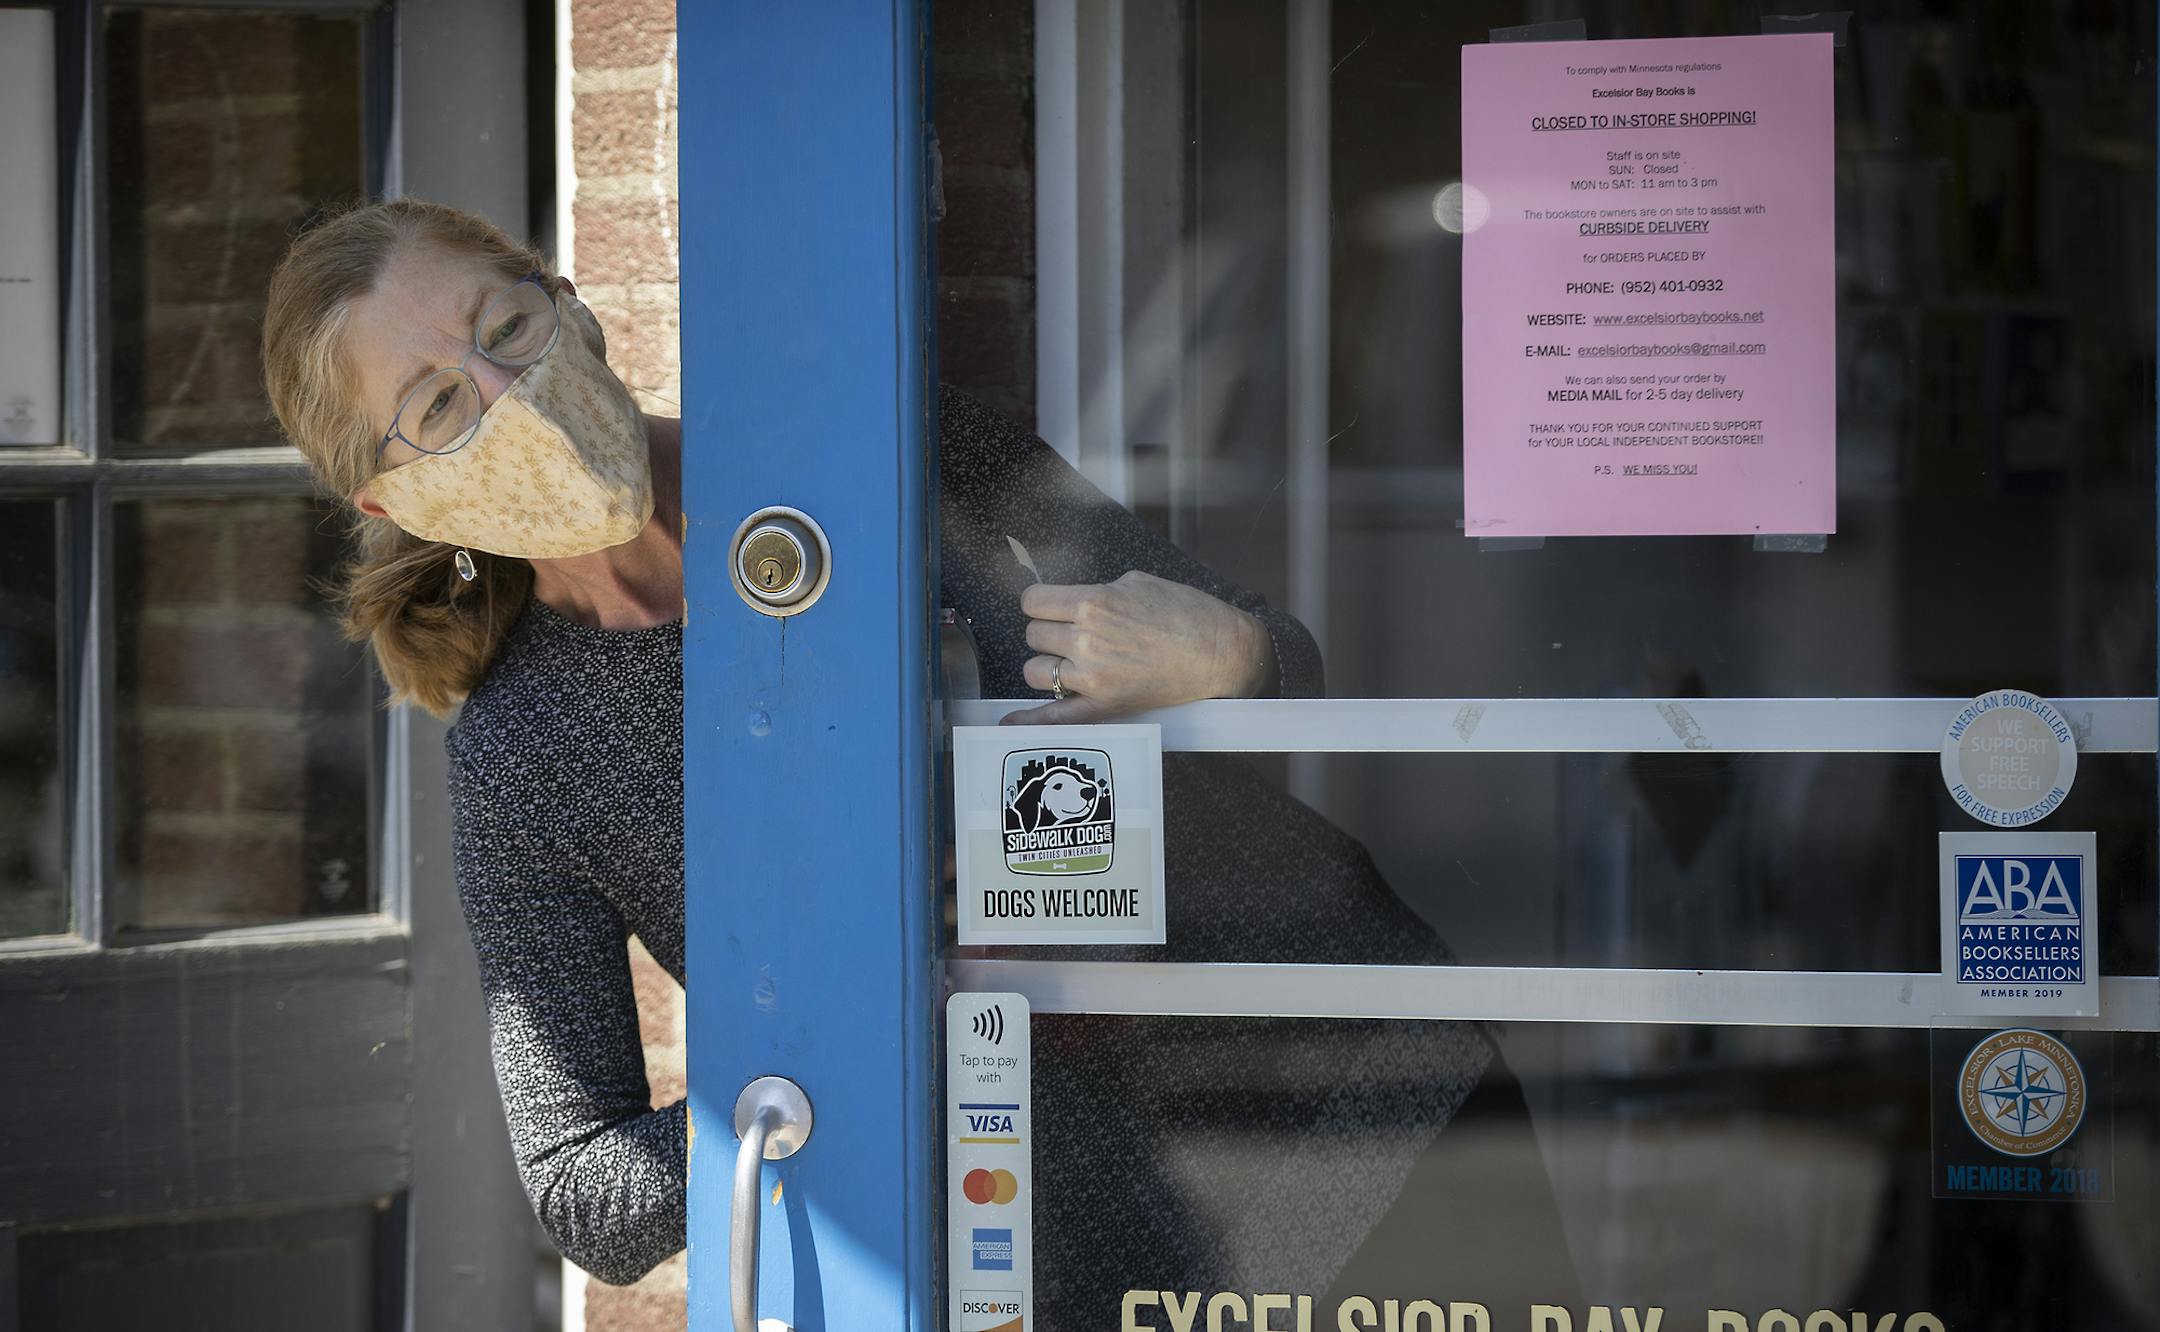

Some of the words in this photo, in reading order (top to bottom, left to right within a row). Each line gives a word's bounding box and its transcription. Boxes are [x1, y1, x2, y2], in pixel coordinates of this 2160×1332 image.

[1565, 66, 1577, 75] To
[1577, 65, 1608, 77] comply
[1608, 64, 1628, 74] with
[1628, 63, 1674, 74] Minnesota
[1675, 62, 1723, 73] regulations
[1592, 87, 1634, 99] Excelsior
[1636, 87, 1654, 99] Bay
[1655, 86, 1685, 97] Books
[1686, 86, 1696, 96] is
[1531, 115, 1587, 130] CLOSED
[1590, 115, 1609, 128] TO
[1612, 113, 1677, 128] IN-STORE
[1679, 110, 1757, 126] SHOPPING!
[1606, 150, 1632, 161] Staff
[1633, 150, 1644, 160] is
[1645, 151, 1659, 160] on
[1660, 149, 1681, 160] site
[1608, 165, 1635, 176] SUN:
[1643, 163, 1679, 175] Closed
[1570, 180, 1597, 191] MON
[1598, 180, 1609, 191] to
[1611, 179, 1635, 190] SAT:
[1640, 178, 1655, 190] 11
[1657, 179, 1675, 189] am
[1677, 178, 1689, 189] to
[1690, 177, 1699, 188] 3
[1700, 179, 1718, 190] pm
[1523, 209, 1544, 220] The
[1545, 208, 1597, 220] bookstore
[1599, 208, 1638, 218] owners
[1639, 208, 1657, 217] are
[1659, 207, 1673, 217] on
[1675, 205, 1696, 217] site
[1697, 205, 1709, 216] to
[1710, 204, 1741, 215] assist
[1743, 204, 1766, 215] with
[1579, 222, 1645, 235] CURBSIDE
[1648, 220, 1710, 234] DELIVERY
[1583, 253, 1598, 263] for
[1600, 252, 1645, 263] ORDERS
[1647, 251, 1689, 262] PLACED
[1691, 251, 1707, 261] BY
[1566, 281, 1615, 294] PHONE:
[1620, 280, 1657, 295] (952)
[1659, 279, 1724, 292] 401-0932
[1527, 313, 1587, 326] WEBSITE:
[1593, 310, 1764, 327] www.excelsiorbaybooks.net
[1525, 345, 1571, 357] E-MAIL:
[1577, 341, 1767, 359] excelsiorbaybooks@gmail.com
[1565, 375, 1582, 385] We
[1584, 376, 1603, 385] can
[1605, 374, 1627, 385] also
[1629, 373, 1655, 384] send
[1657, 374, 1681, 385] your
[1683, 373, 1712, 384] order
[1714, 372, 1726, 384] by
[1547, 389, 1589, 402] MEDIA
[1591, 388, 1623, 401] MAIL
[1625, 389, 1643, 401] for
[1646, 388, 1667, 400] 2-5
[1670, 388, 1693, 401] day
[1695, 386, 1745, 401] delivery
[1528, 423, 1565, 434] THANK
[1566, 422, 1590, 434] YOU
[1592, 421, 1614, 433] FOR
[1615, 421, 1646, 433] YOUR
[1647, 420, 1711, 432] CONTINUED
[1712, 420, 1763, 431] SUPPORT
[1527, 437, 1543, 448] for
[1544, 437, 1575, 448] YOUR
[1576, 436, 1611, 447] LOCAL
[1612, 435, 1689, 447] INDEPENDENT
[1691, 434, 1764, 446] BOOKSTORE!!
[1594, 465, 1615, 475] P.S.
[1623, 464, 1641, 475] WE
[1642, 464, 1671, 475] MISS
[1672, 463, 1698, 474] YOU!
[1949, 695, 1999, 742] AMERICAN
[2002, 693, 2071, 744] BOOKSELLERS
[1997, 720, 2023, 735] WE
[1971, 736, 2049, 753] SUPPORT
[1989, 755, 2029, 772] FREE
[1977, 773, 2040, 790] SPEECH
[1952, 784, 1972, 808] FOR
[1971, 802, 1999, 824] FREE
[2002, 786, 2065, 825] EXPRESSION
[1077, 824, 1104, 844] DOG
[1019, 852, 1036, 862] TWIN
[1038, 850, 1060, 860] CITIES
[1063, 845, 1102, 858] UNLEASHED
[1960, 860, 2078, 919] ABA
[984, 889, 1036, 918] DOGS
[1042, 889, 1139, 917] WELCOME
[1962, 927, 2080, 940] AMERICAN
[1963, 946, 2080, 960] BOOKSELLERS
[1962, 966, 2080, 980] ASSOCIATION
[1980, 989, 2029, 997] MEMBER
[2035, 989, 2063, 998] 2019
[1999, 1035, 2035, 1048] LAKE
[959, 1054, 980, 1069] Tap
[981, 1055, 995, 1067] to
[997, 1056, 1018, 1069] pay
[976, 1072, 1001, 1083] with
[966, 1114, 1014, 1133] VISA
[1946, 1165, 2042, 1193] MEMBER
[963, 1302, 1019, 1314] DISCOVER
